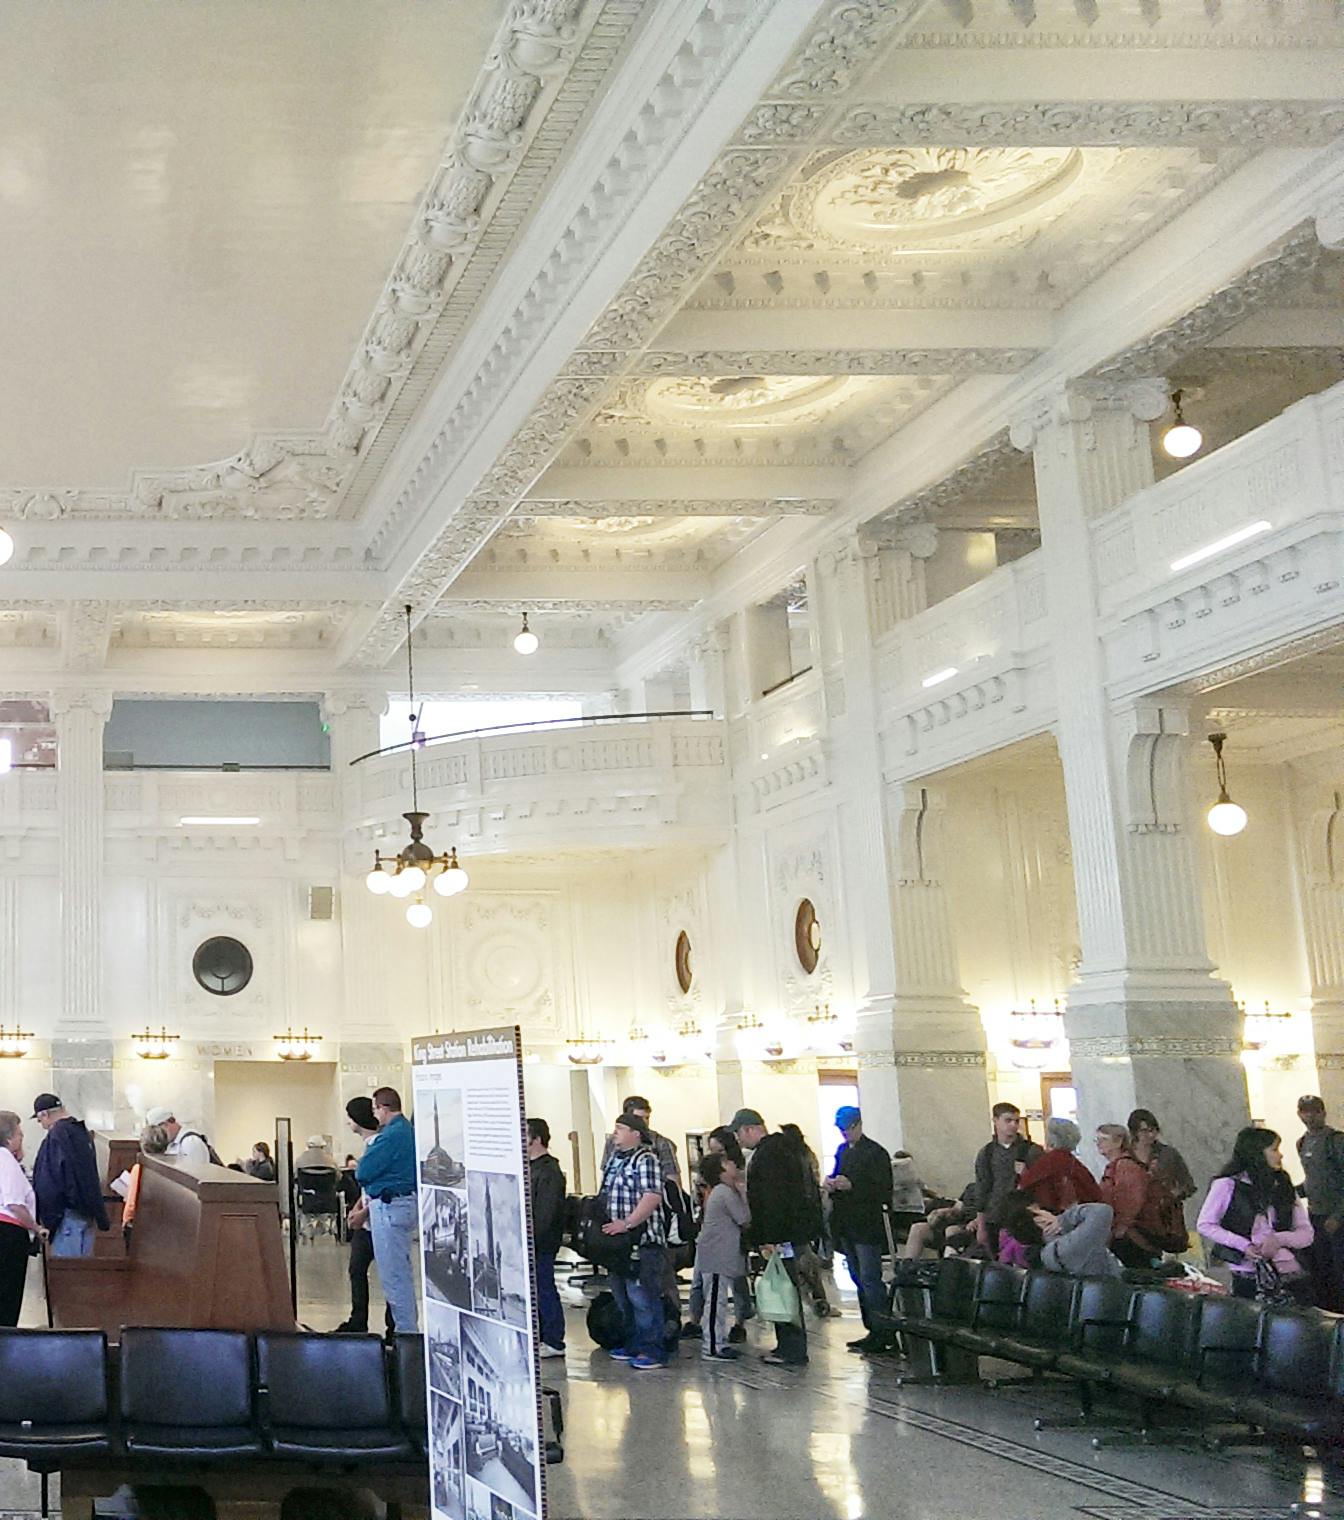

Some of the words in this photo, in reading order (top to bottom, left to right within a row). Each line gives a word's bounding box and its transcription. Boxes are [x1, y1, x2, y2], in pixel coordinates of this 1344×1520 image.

[196, 1045, 256, 1057] WOMEN
[427, 1042, 444, 1060] Street
[445, 1039, 466, 1058] Station
